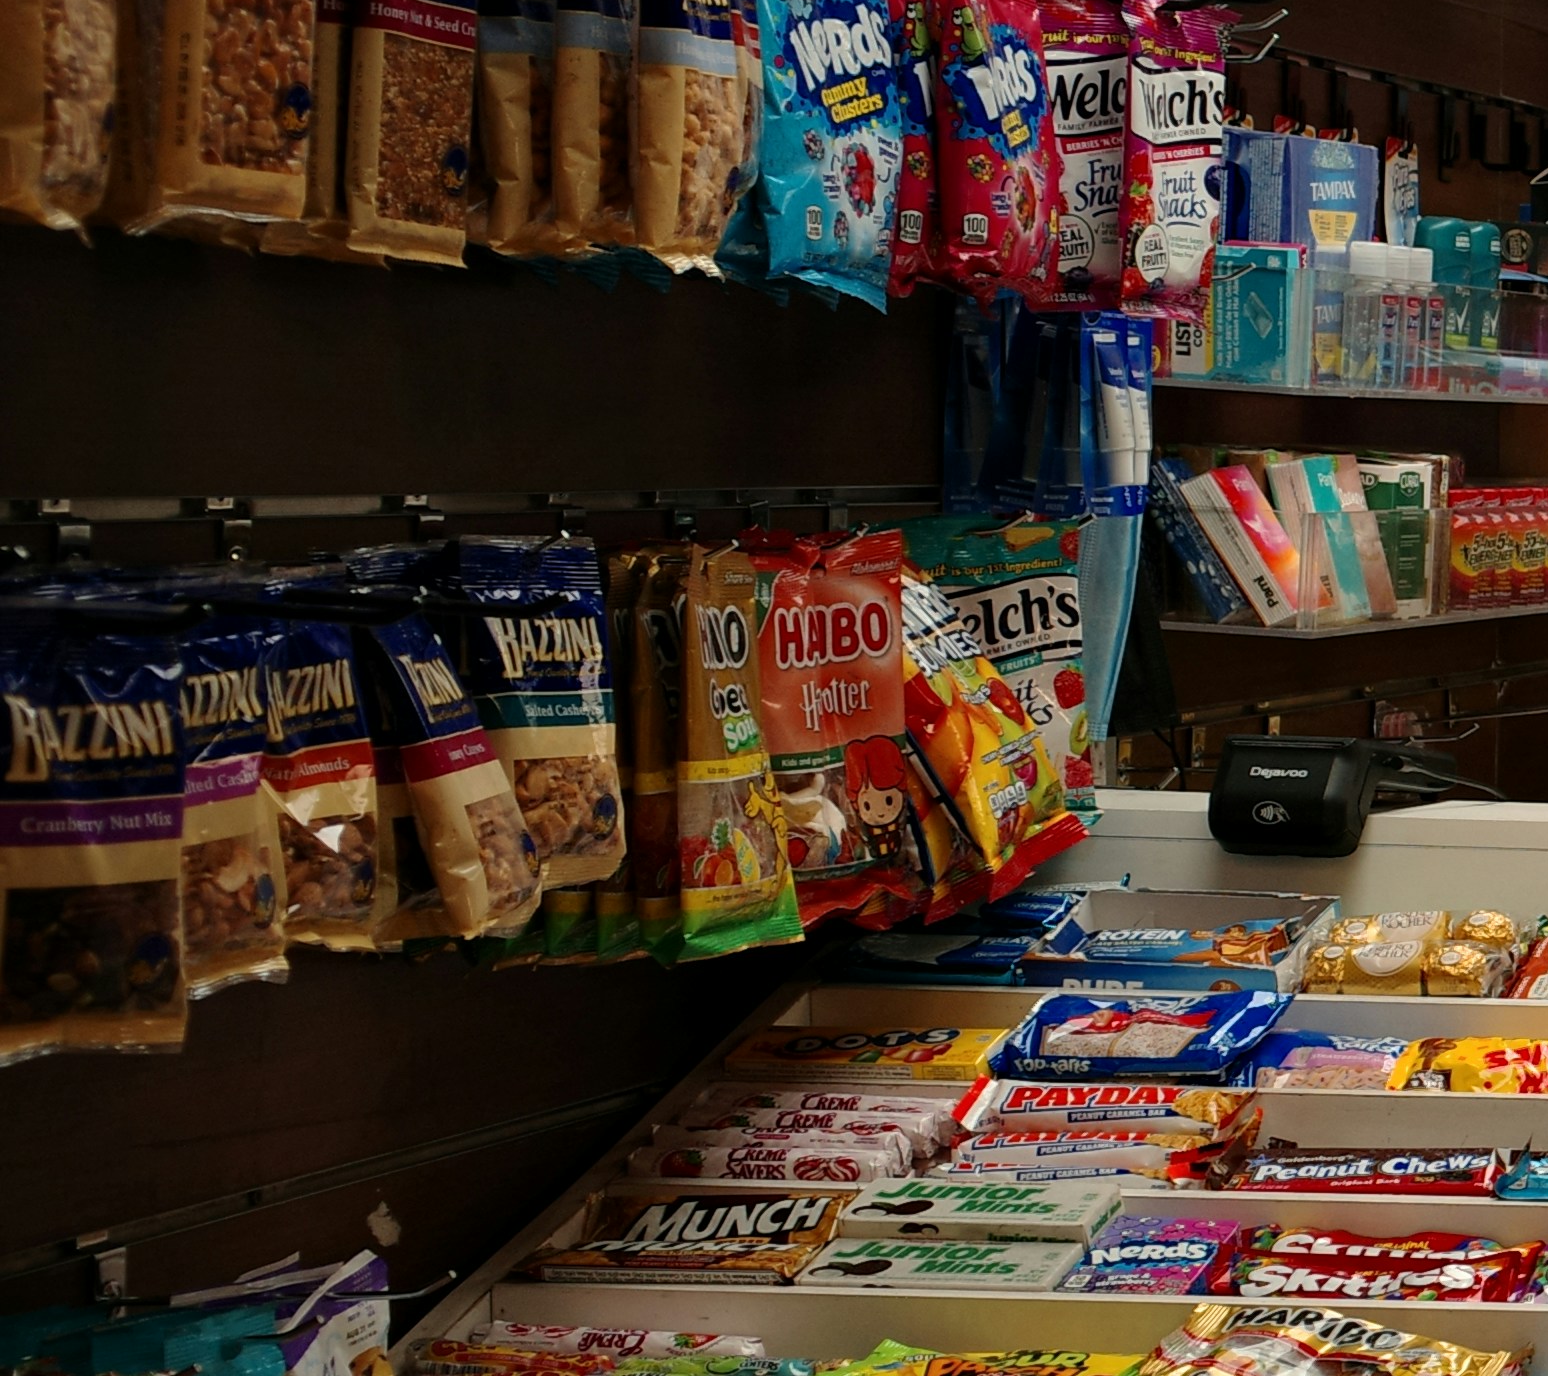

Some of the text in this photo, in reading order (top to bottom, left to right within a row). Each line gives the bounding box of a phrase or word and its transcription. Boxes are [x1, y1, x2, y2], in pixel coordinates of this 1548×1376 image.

[1309, 178, 1357, 201] TAMPAX
[4, 694, 175, 784] BAZZINI
[1256, 1152, 1489, 1183] Peanut Chews
